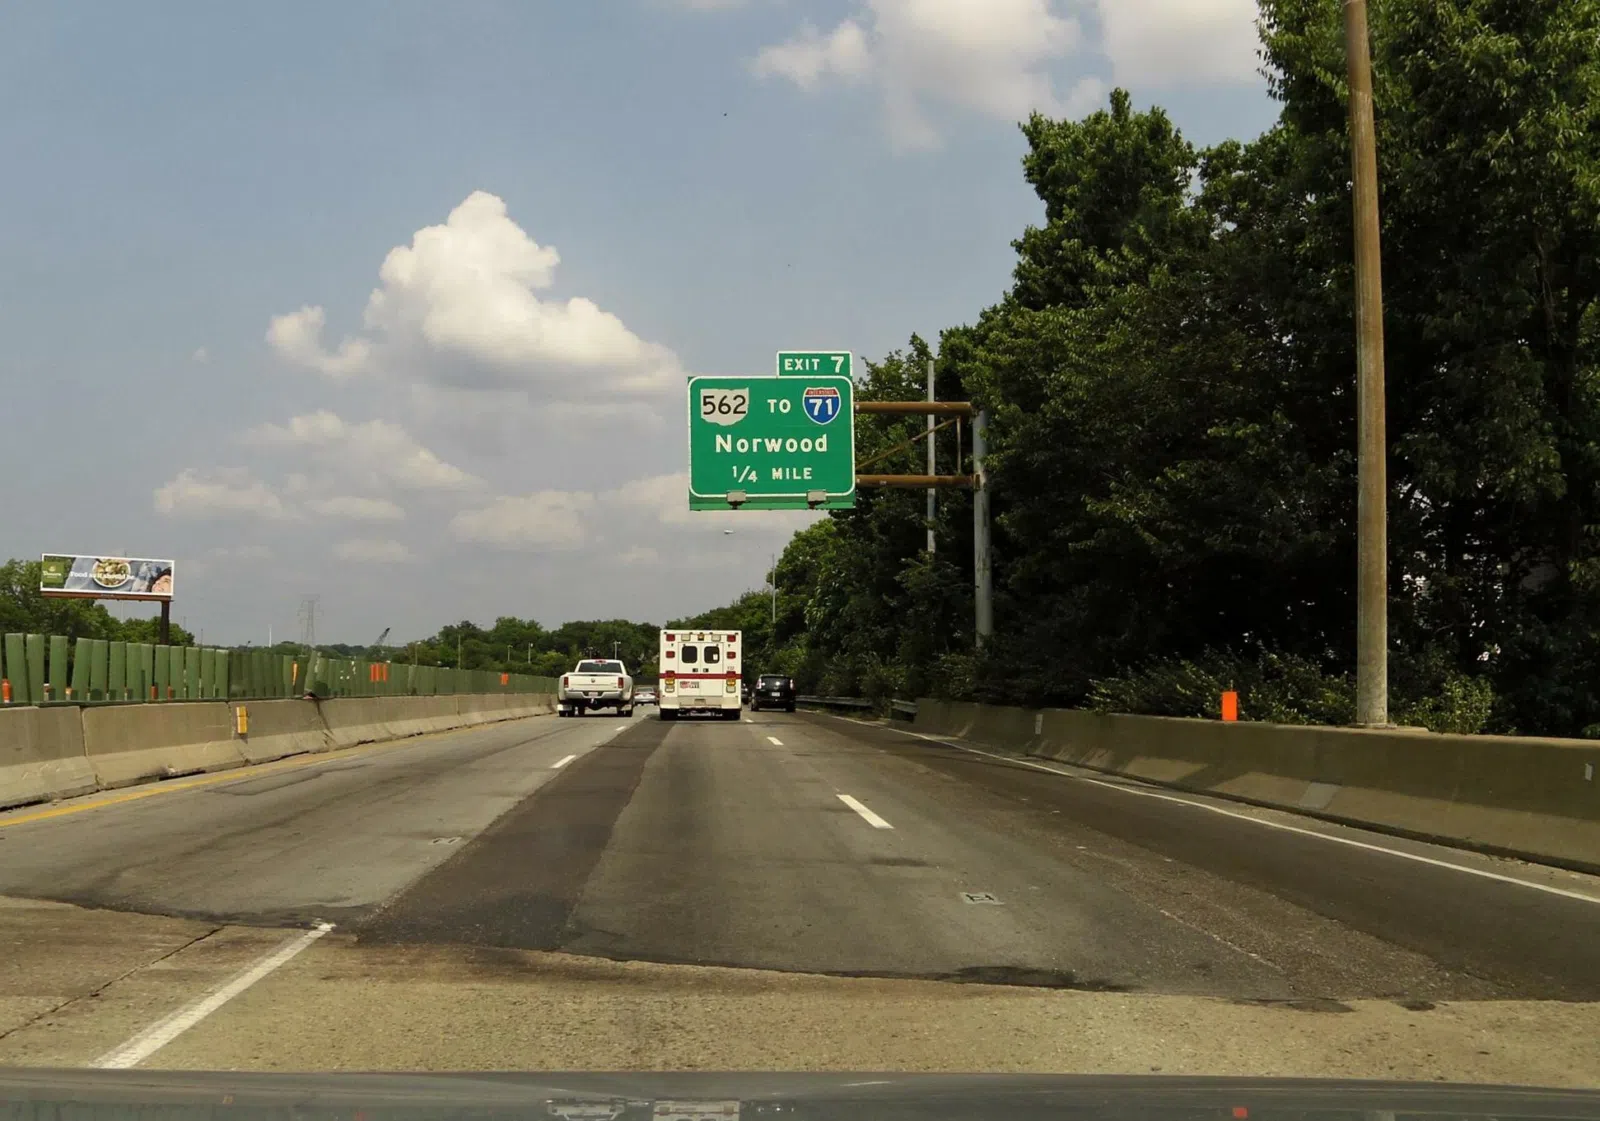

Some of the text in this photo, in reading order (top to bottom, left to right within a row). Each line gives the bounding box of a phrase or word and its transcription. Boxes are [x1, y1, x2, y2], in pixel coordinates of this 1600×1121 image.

[784, 356, 845, 373] EXIT 7
[703, 394, 833, 416] 562 TO 71
[715, 433, 828, 453] Norwood
[732, 466, 813, 483] 1/4 MILE
